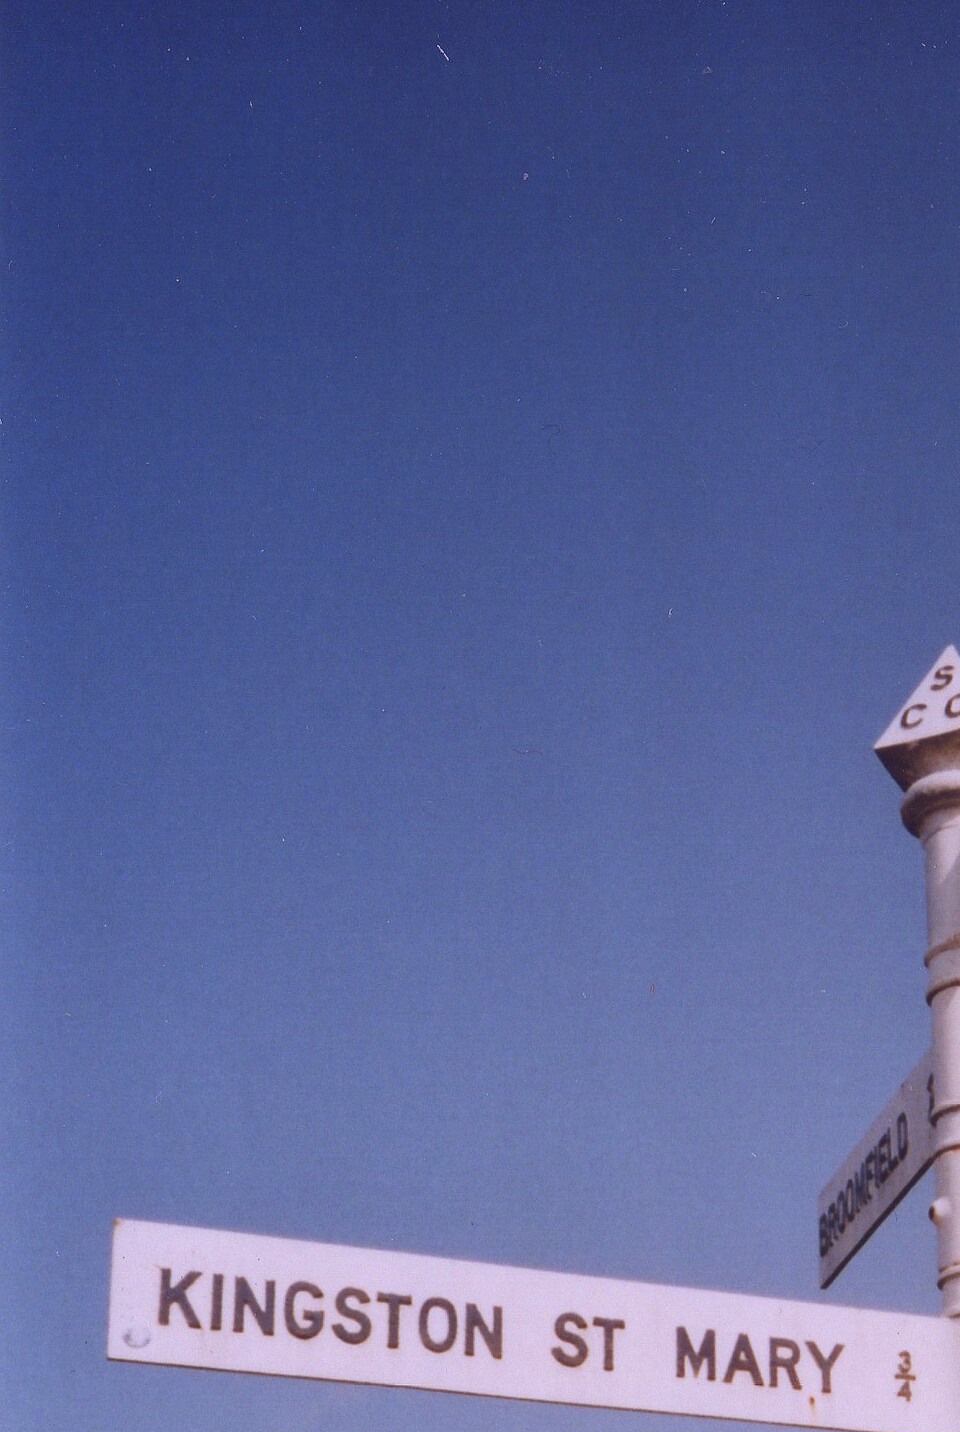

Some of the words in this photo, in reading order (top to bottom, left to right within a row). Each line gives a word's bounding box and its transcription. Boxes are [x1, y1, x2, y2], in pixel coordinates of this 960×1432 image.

[819, 1111, 909, 1258] BROOMFIELD
[157, 1267, 504, 1359] KINGSTON
[550, 1312, 626, 1372] ST
[675, 1326, 845, 1394] MARY
